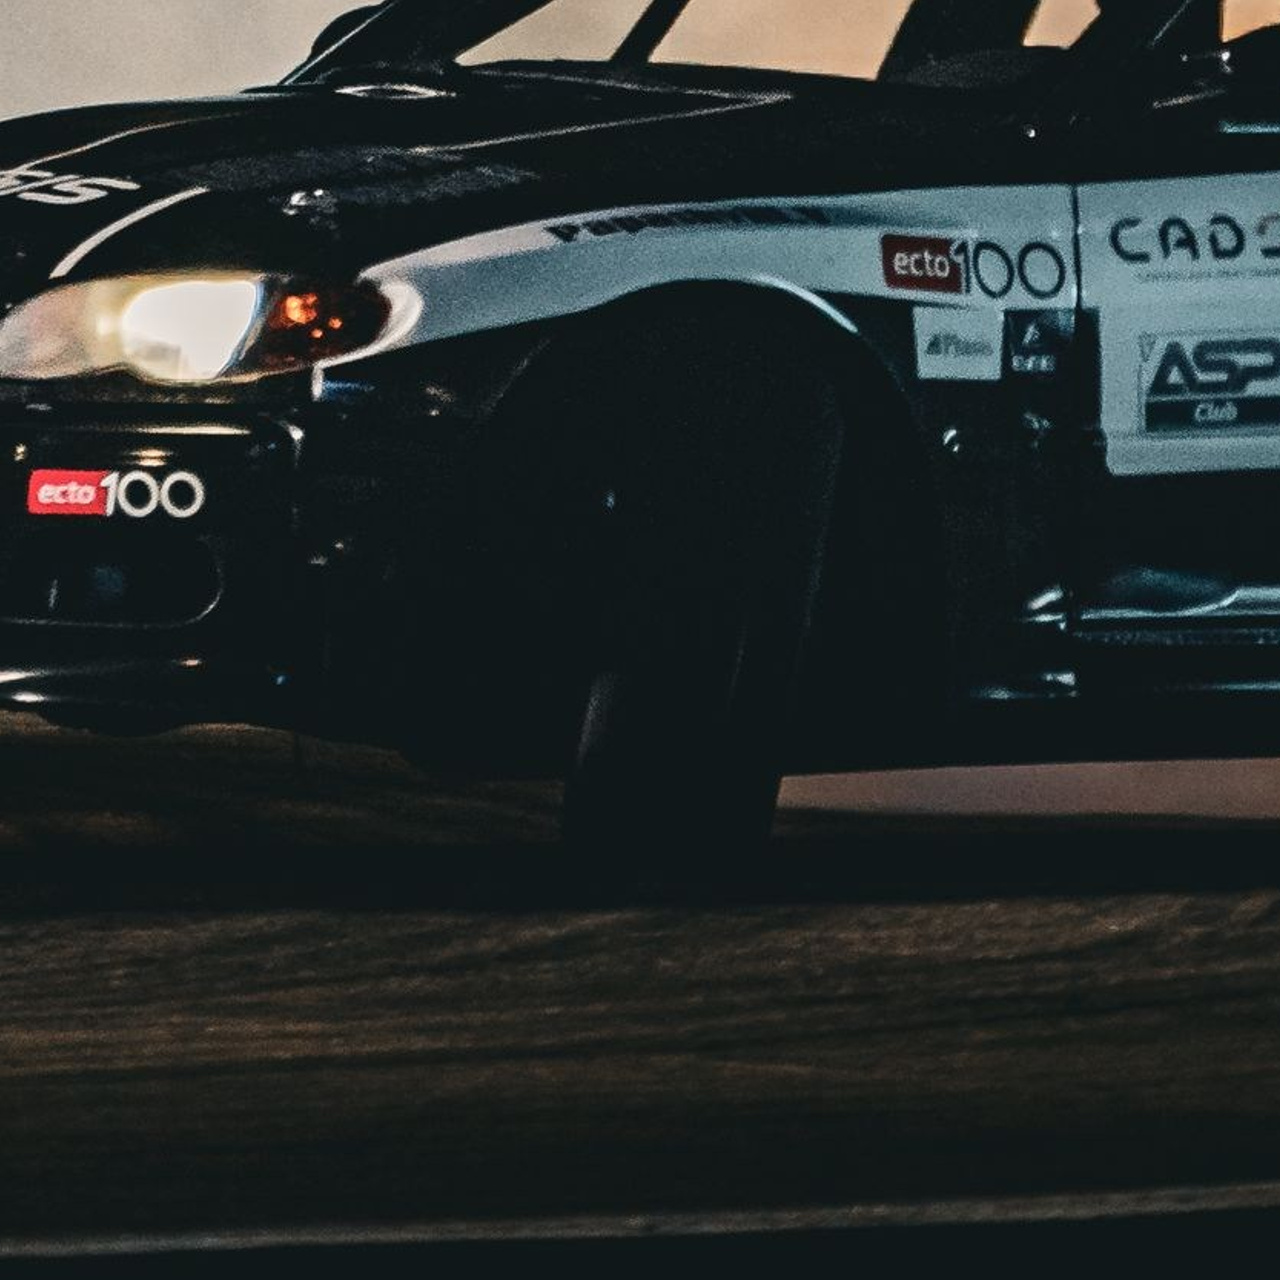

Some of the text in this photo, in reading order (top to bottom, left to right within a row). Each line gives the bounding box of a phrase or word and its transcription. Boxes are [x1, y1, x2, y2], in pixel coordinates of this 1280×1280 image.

[893, 239, 1066, 300] ecto 100
[37, 470, 206, 519] ecto 100
